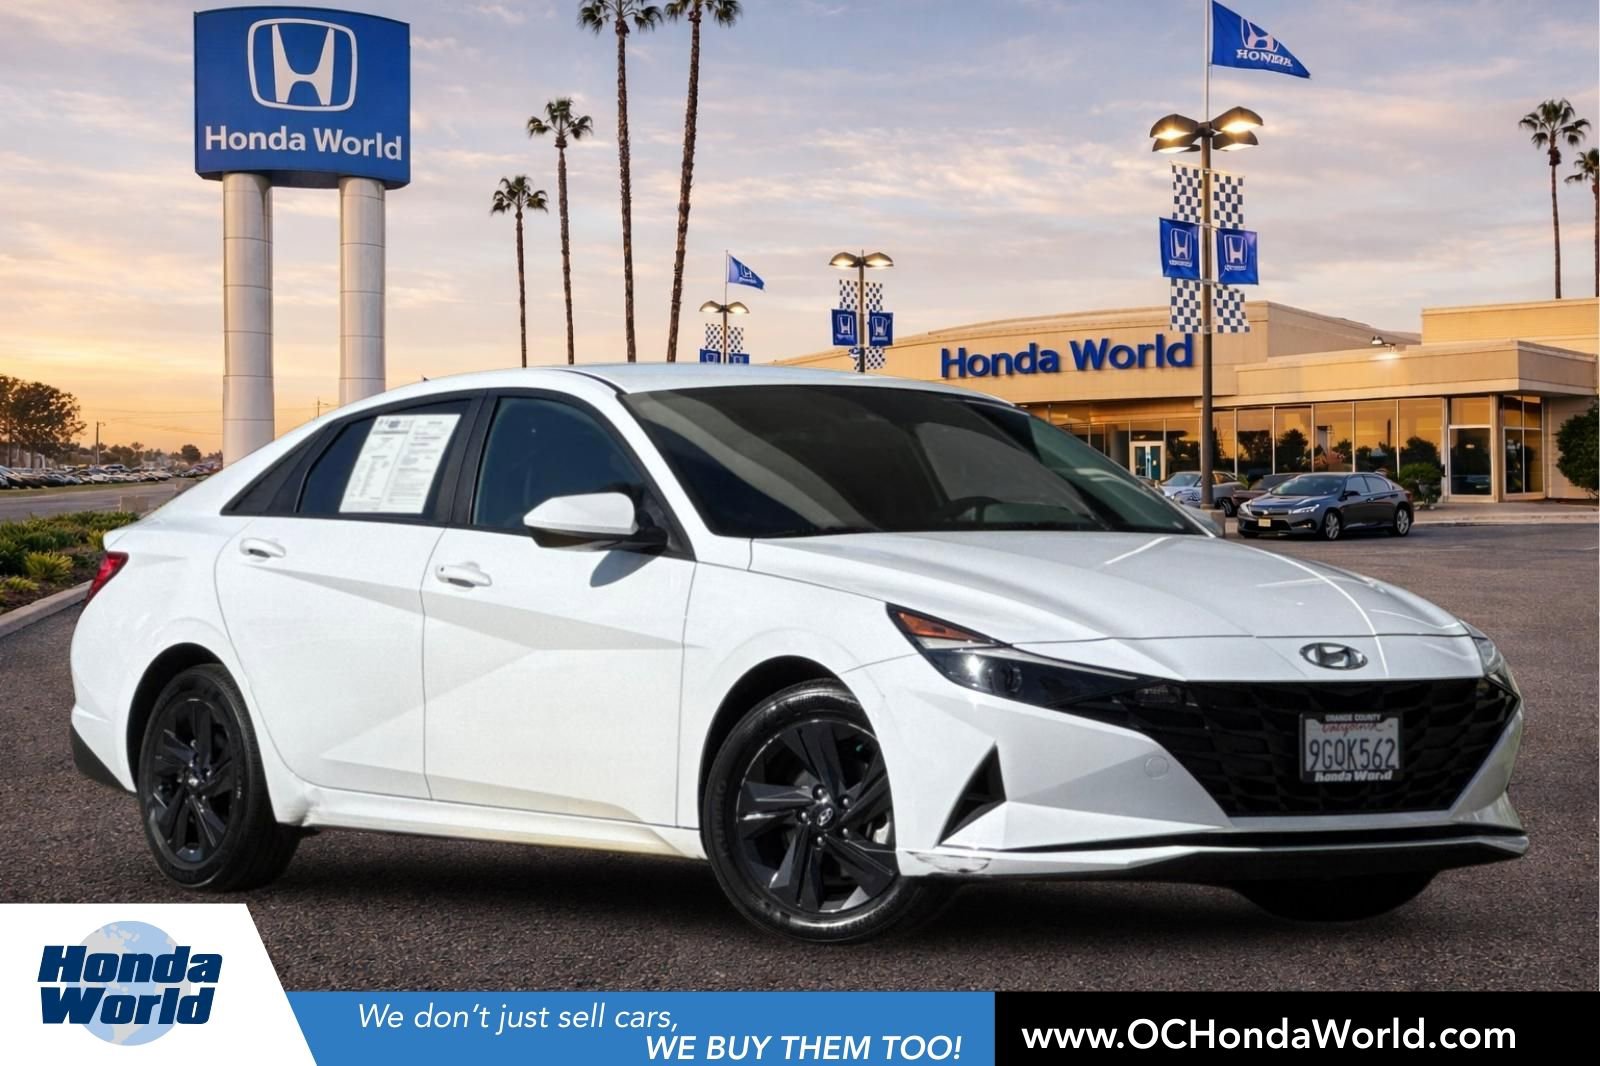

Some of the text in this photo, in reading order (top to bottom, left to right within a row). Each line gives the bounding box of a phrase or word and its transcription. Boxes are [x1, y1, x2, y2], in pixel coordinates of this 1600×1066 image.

[205, 125, 402, 161] Honda World
[941, 333, 1194, 378] Honda World
[1315, 769, 1393, 782] Honda World
